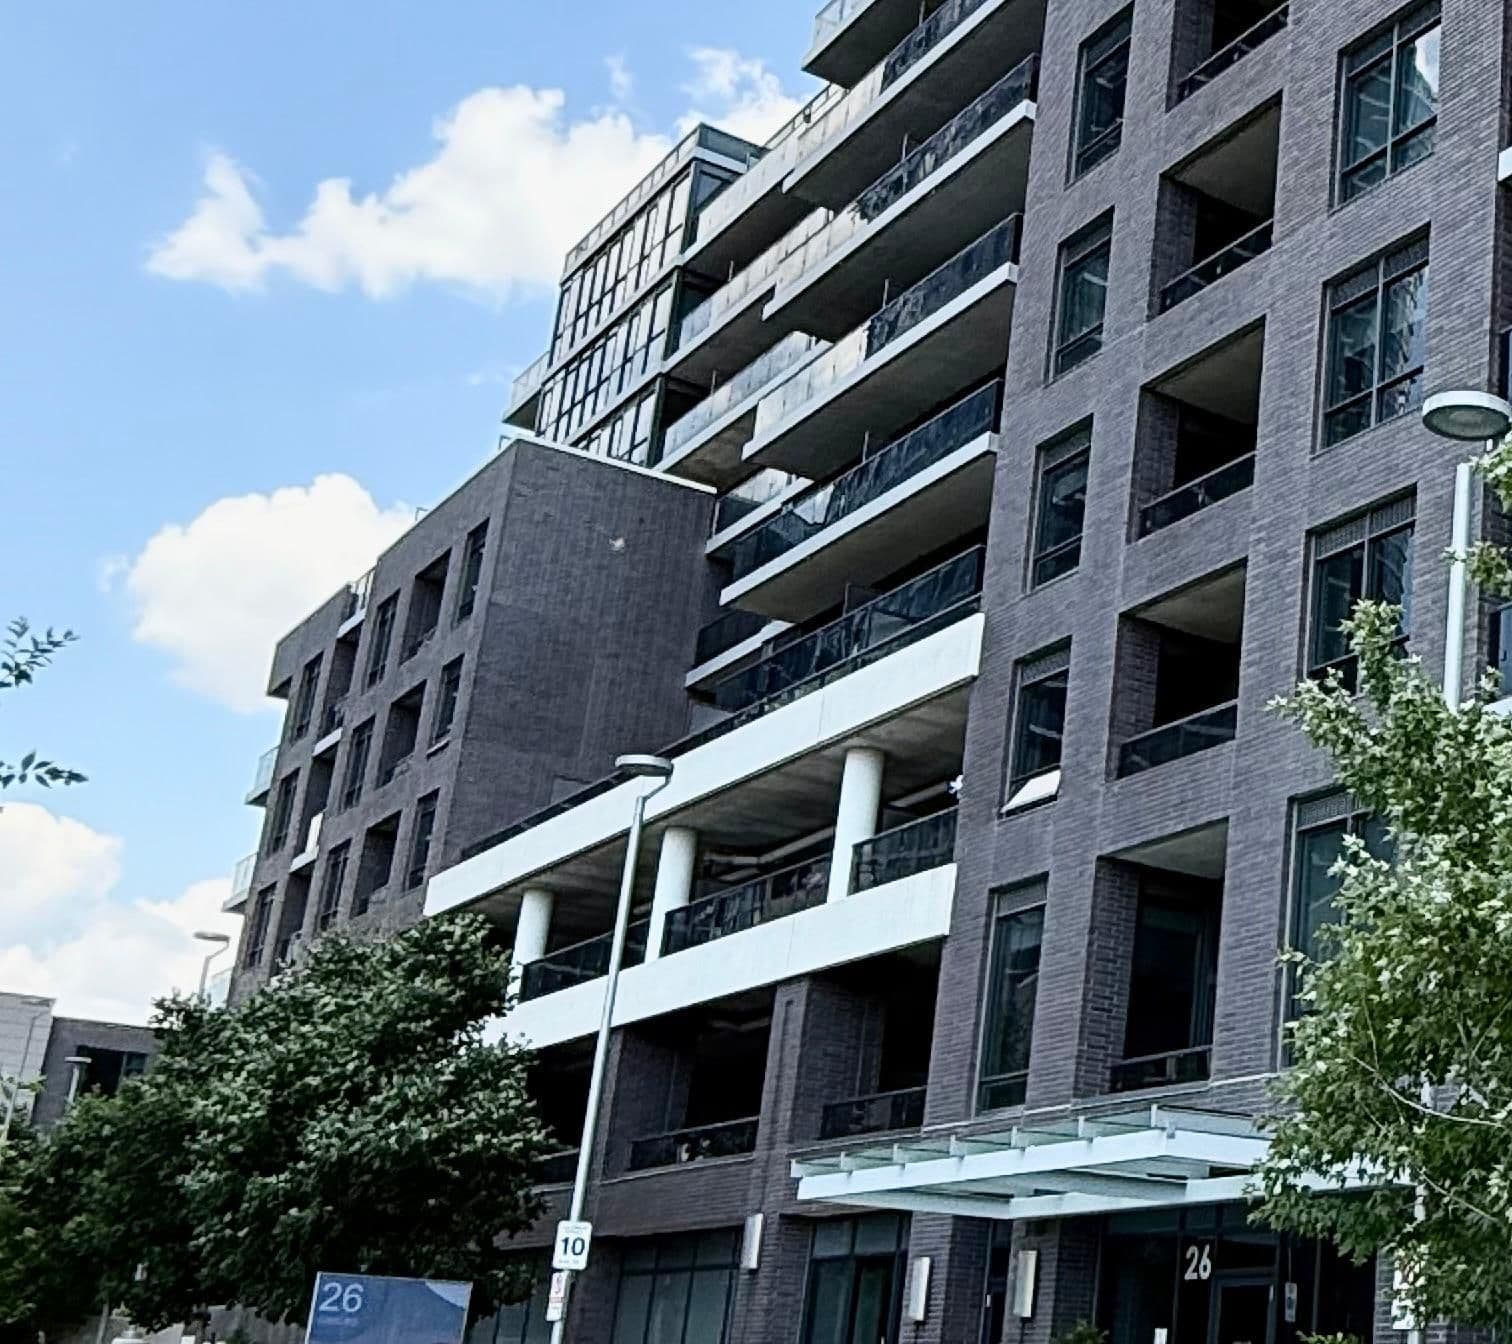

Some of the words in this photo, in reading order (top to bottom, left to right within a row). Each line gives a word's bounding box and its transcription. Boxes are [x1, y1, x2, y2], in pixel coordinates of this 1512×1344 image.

[561, 1237, 585, 1256] 10
[1184, 1244, 1211, 1280] 26
[319, 1282, 364, 1312] 26
